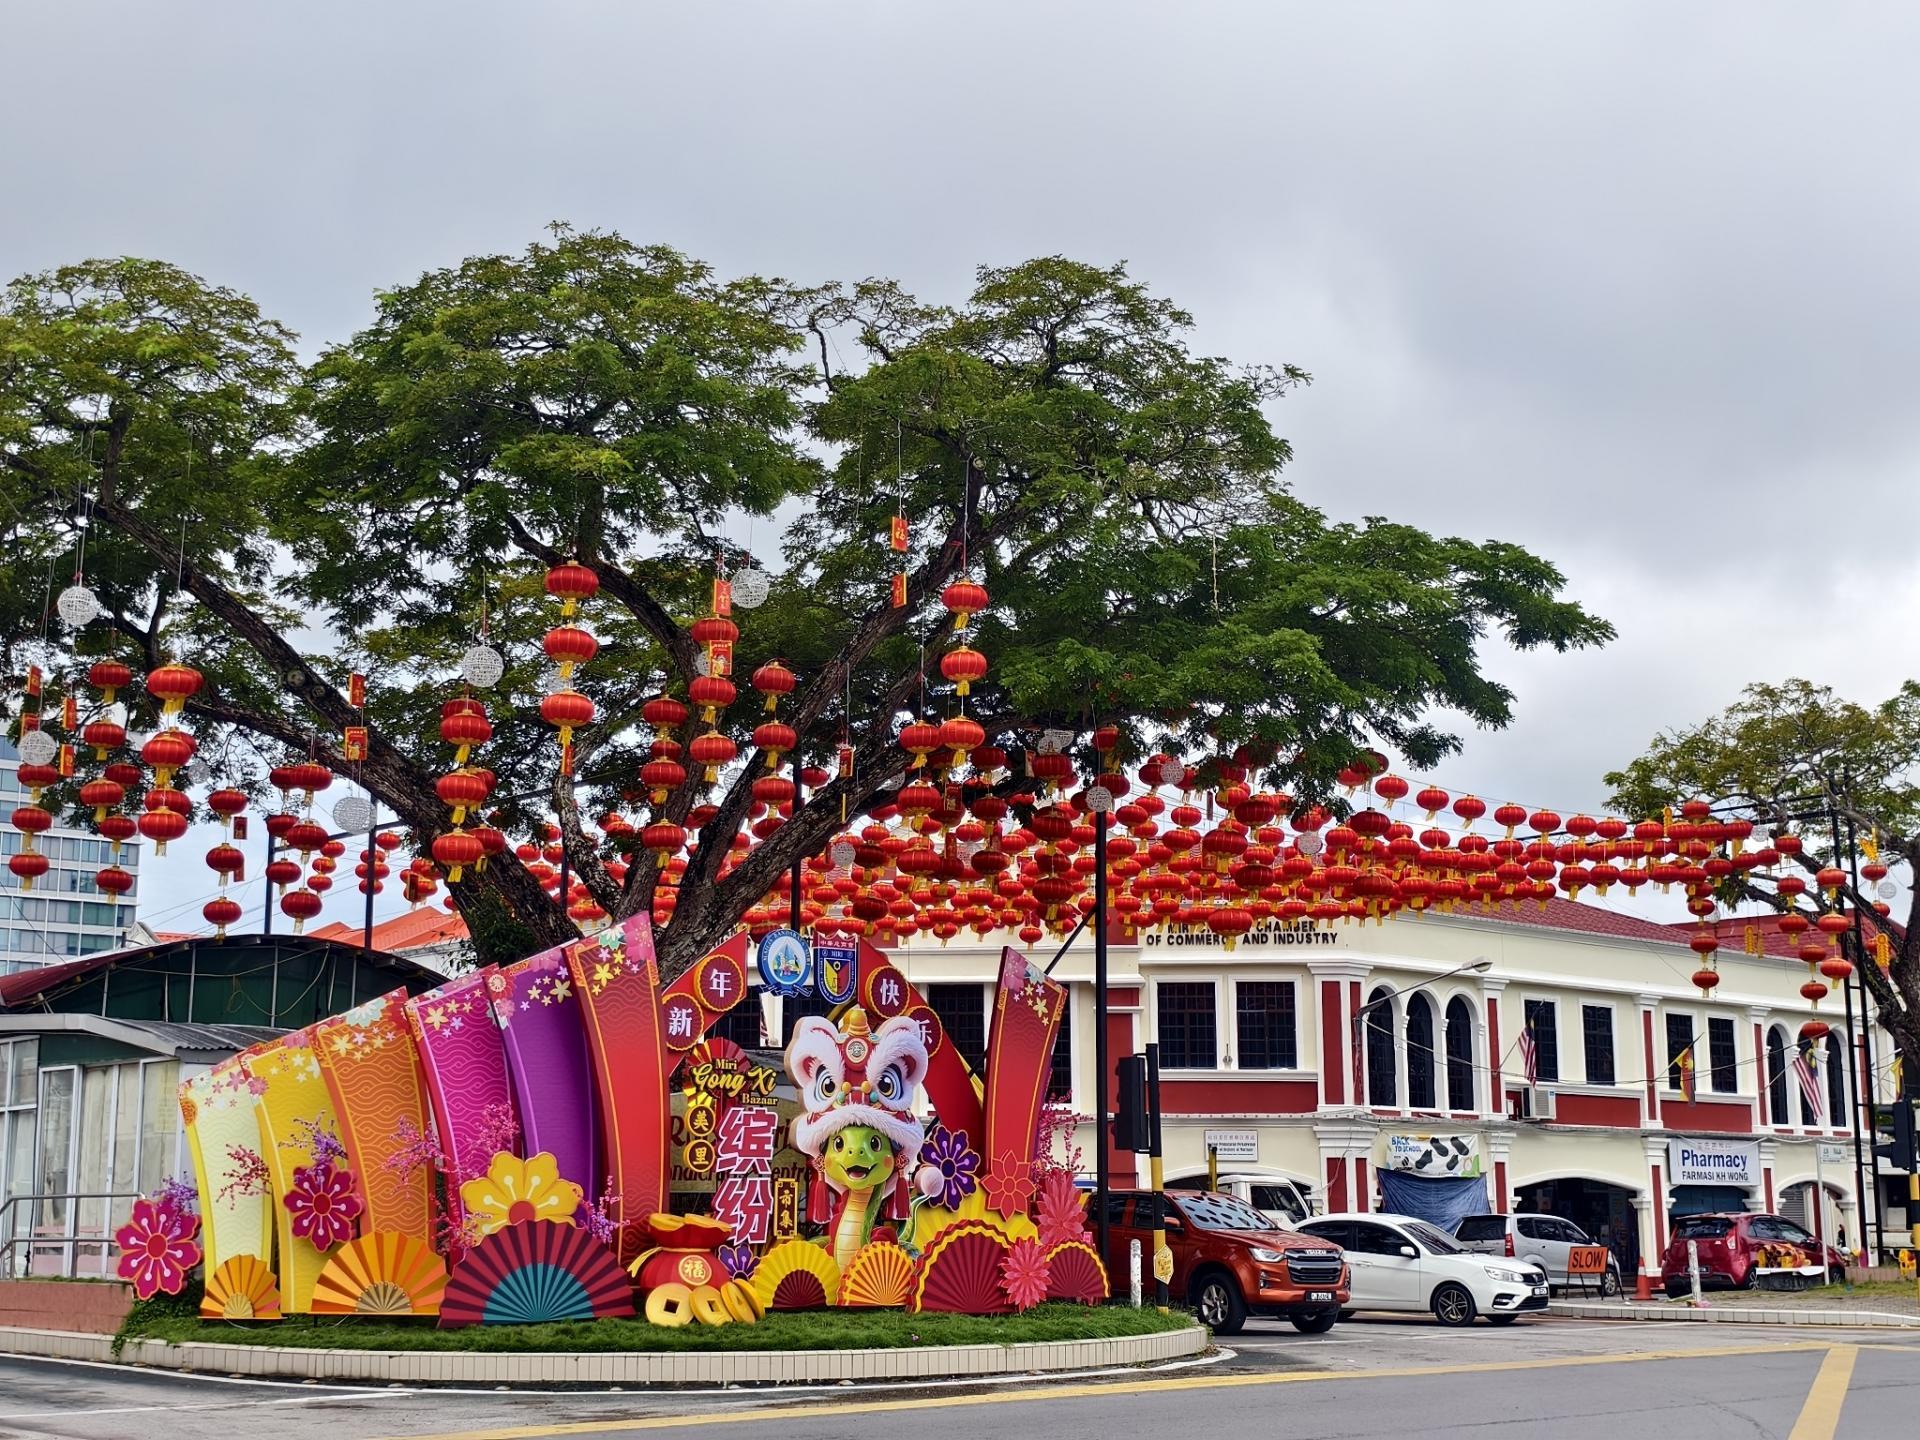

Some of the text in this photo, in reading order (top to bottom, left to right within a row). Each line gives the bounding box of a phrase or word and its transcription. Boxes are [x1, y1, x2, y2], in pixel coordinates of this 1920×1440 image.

[1146, 932, 1338, 946] OF COMMERC AND INDUSTRY
[668, 1007, 692, 1037] 新
[708, 968, 732, 998] 年
[880, 978, 900, 1007] 快
[715, 1058, 738, 1070] Miri
[691, 1063, 777, 1098] Gong Xi
[742, 1092, 778, 1106] Bazaar
[1391, 1135, 1410, 1146] BACK
[1394, 1145, 1402, 1153] TO
[1681, 1149, 1748, 1171] Pharmacy
[1682, 1170, 1749, 1181] FARMASI KH WONG
[1571, 1250, 1604, 1269] SLOW
[684, 1258, 706, 1280] 福
